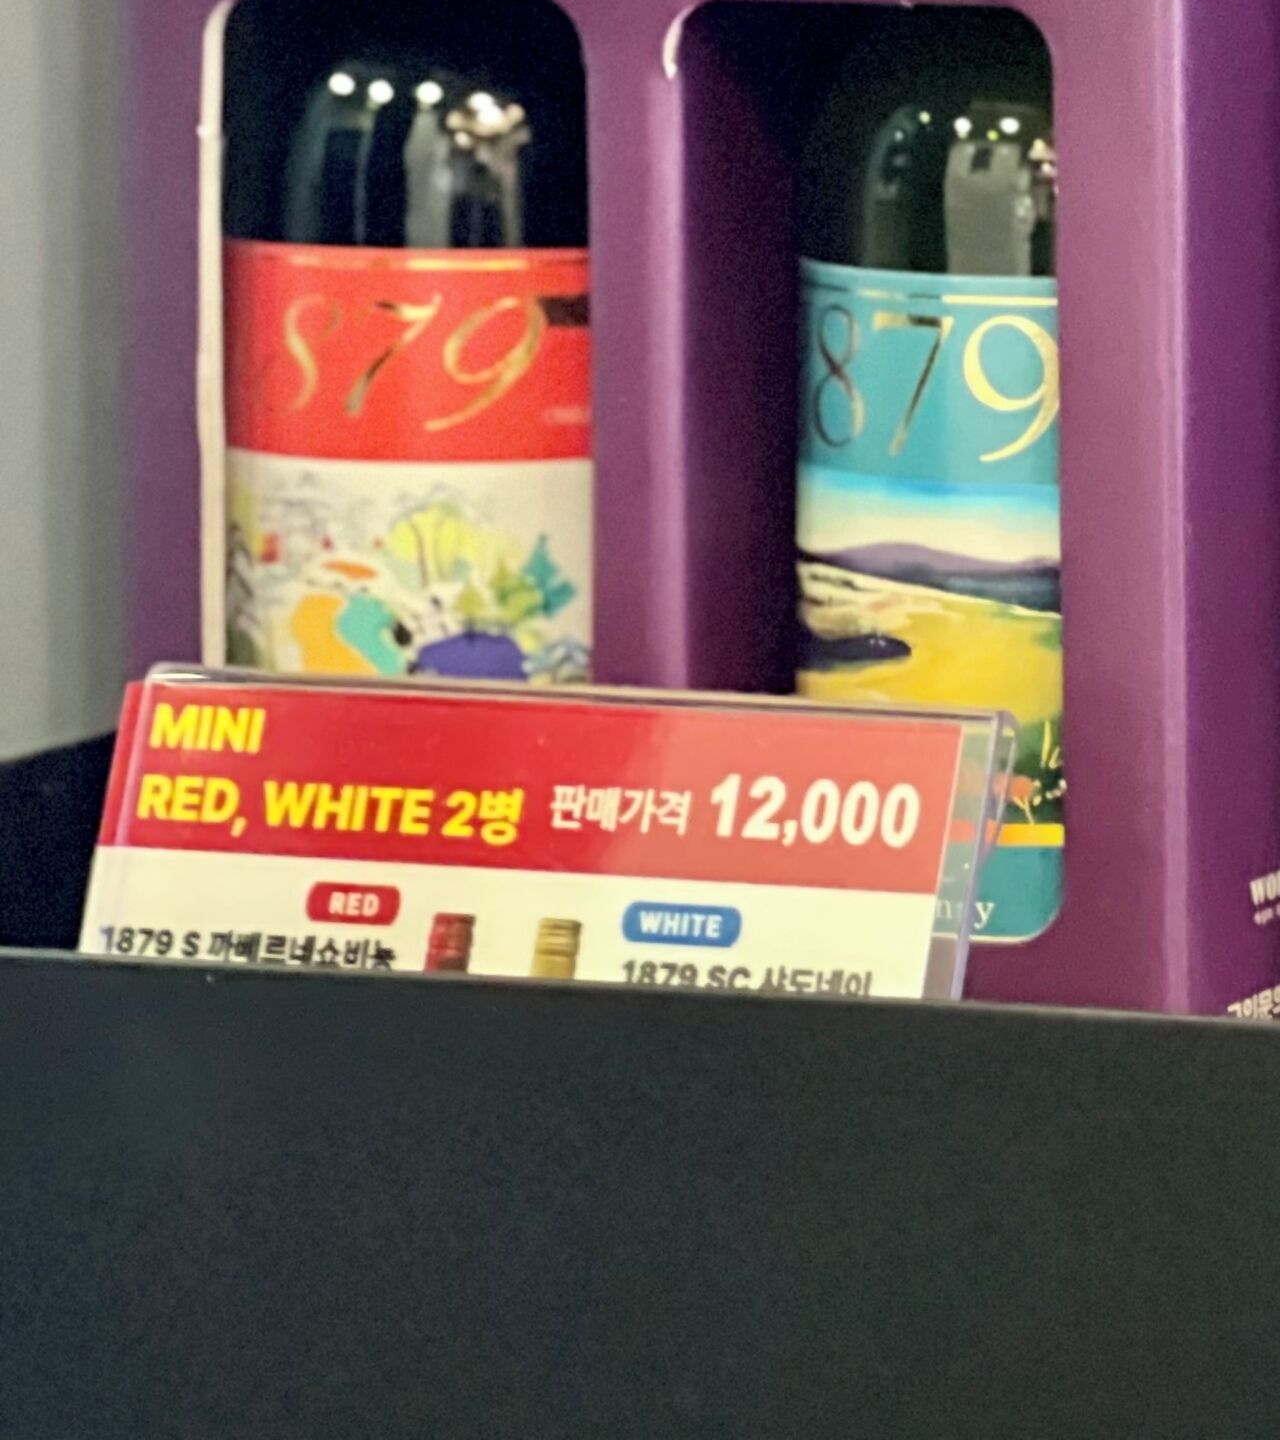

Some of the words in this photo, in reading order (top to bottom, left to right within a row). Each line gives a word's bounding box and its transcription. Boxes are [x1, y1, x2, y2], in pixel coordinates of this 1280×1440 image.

[149, 703, 266, 754] MINI
[136, 773, 248, 838] RED,
[264, 780, 435, 835] WHITE
[441, 787, 525, 846] 2병
[550, 784, 693, 835] 판매가격
[710, 773, 921, 849] 12,000
[328, 890, 380, 918] RED
[100, 926, 174, 955] 1879
[182, 931, 201, 957] S
[638, 911, 723, 939] WHITE
[622, 960, 699, 988] 1879
